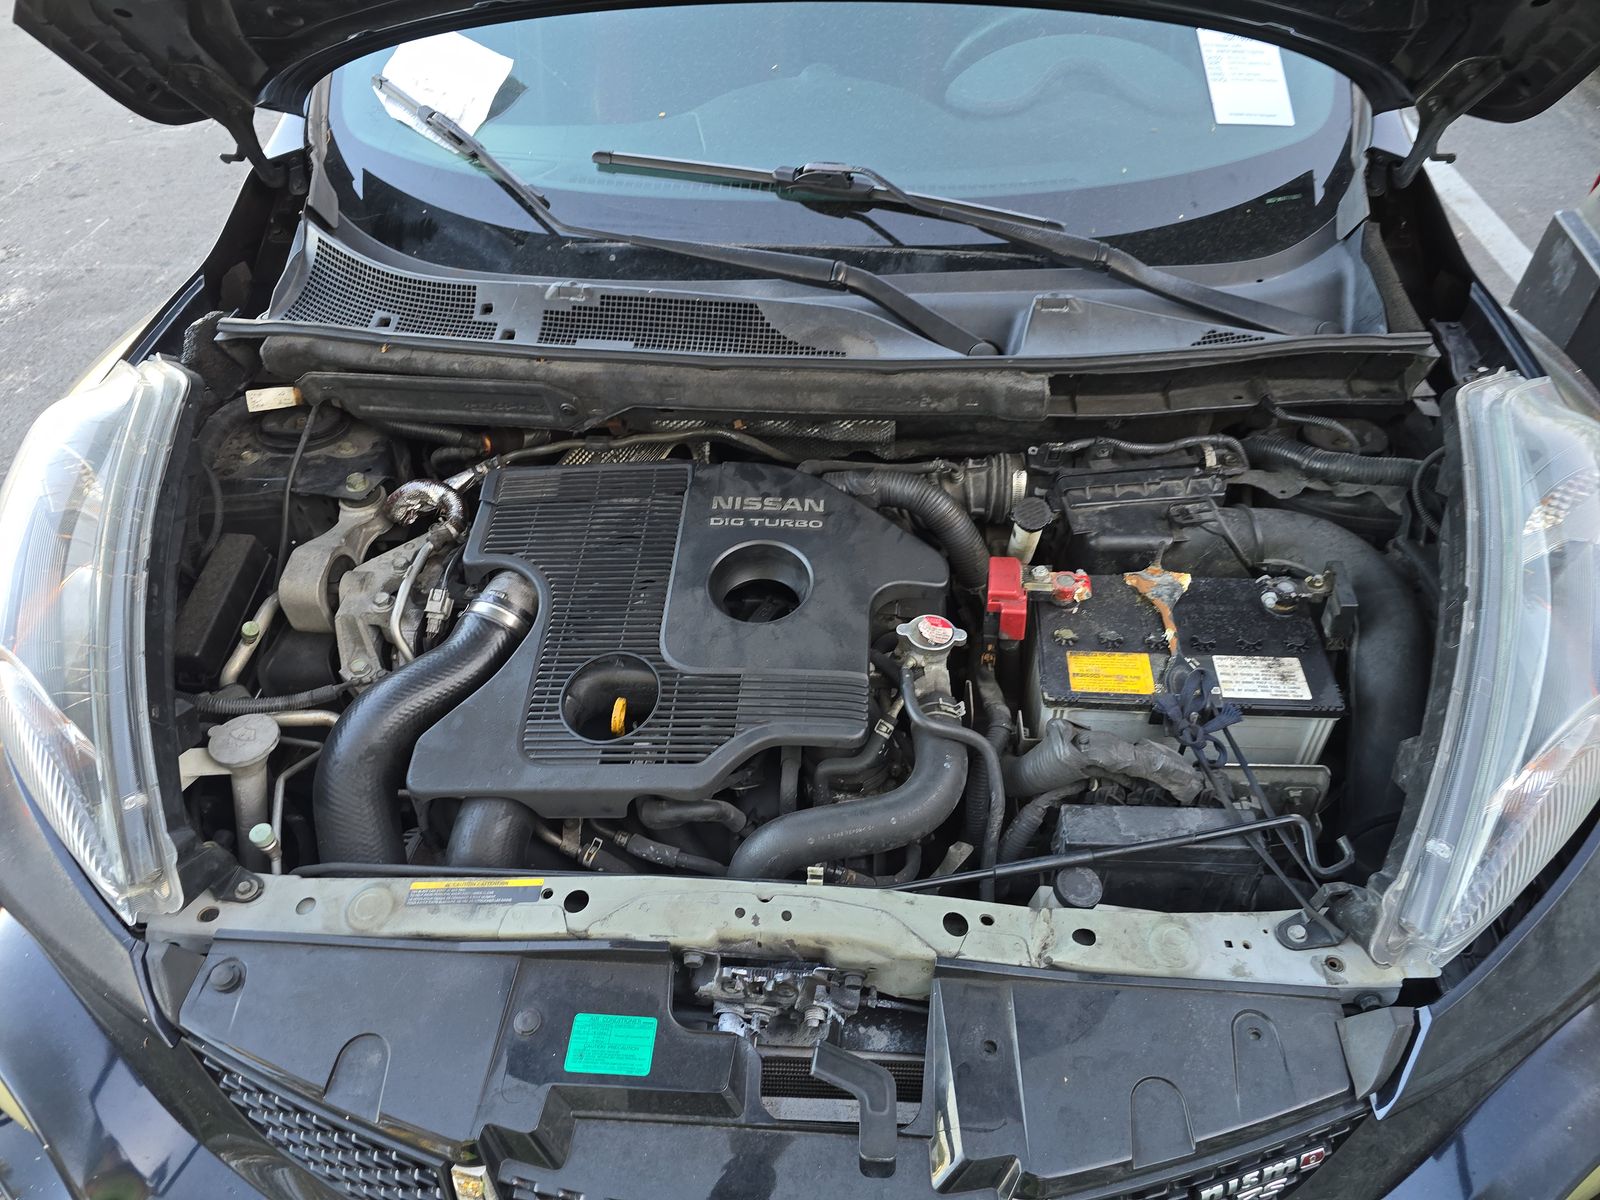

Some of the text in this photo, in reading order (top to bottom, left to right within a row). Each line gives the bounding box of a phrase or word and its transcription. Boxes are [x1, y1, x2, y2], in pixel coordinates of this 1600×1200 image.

[711, 496, 825, 513] NISSAN
[709, 517, 824, 529] DIG TURBO
